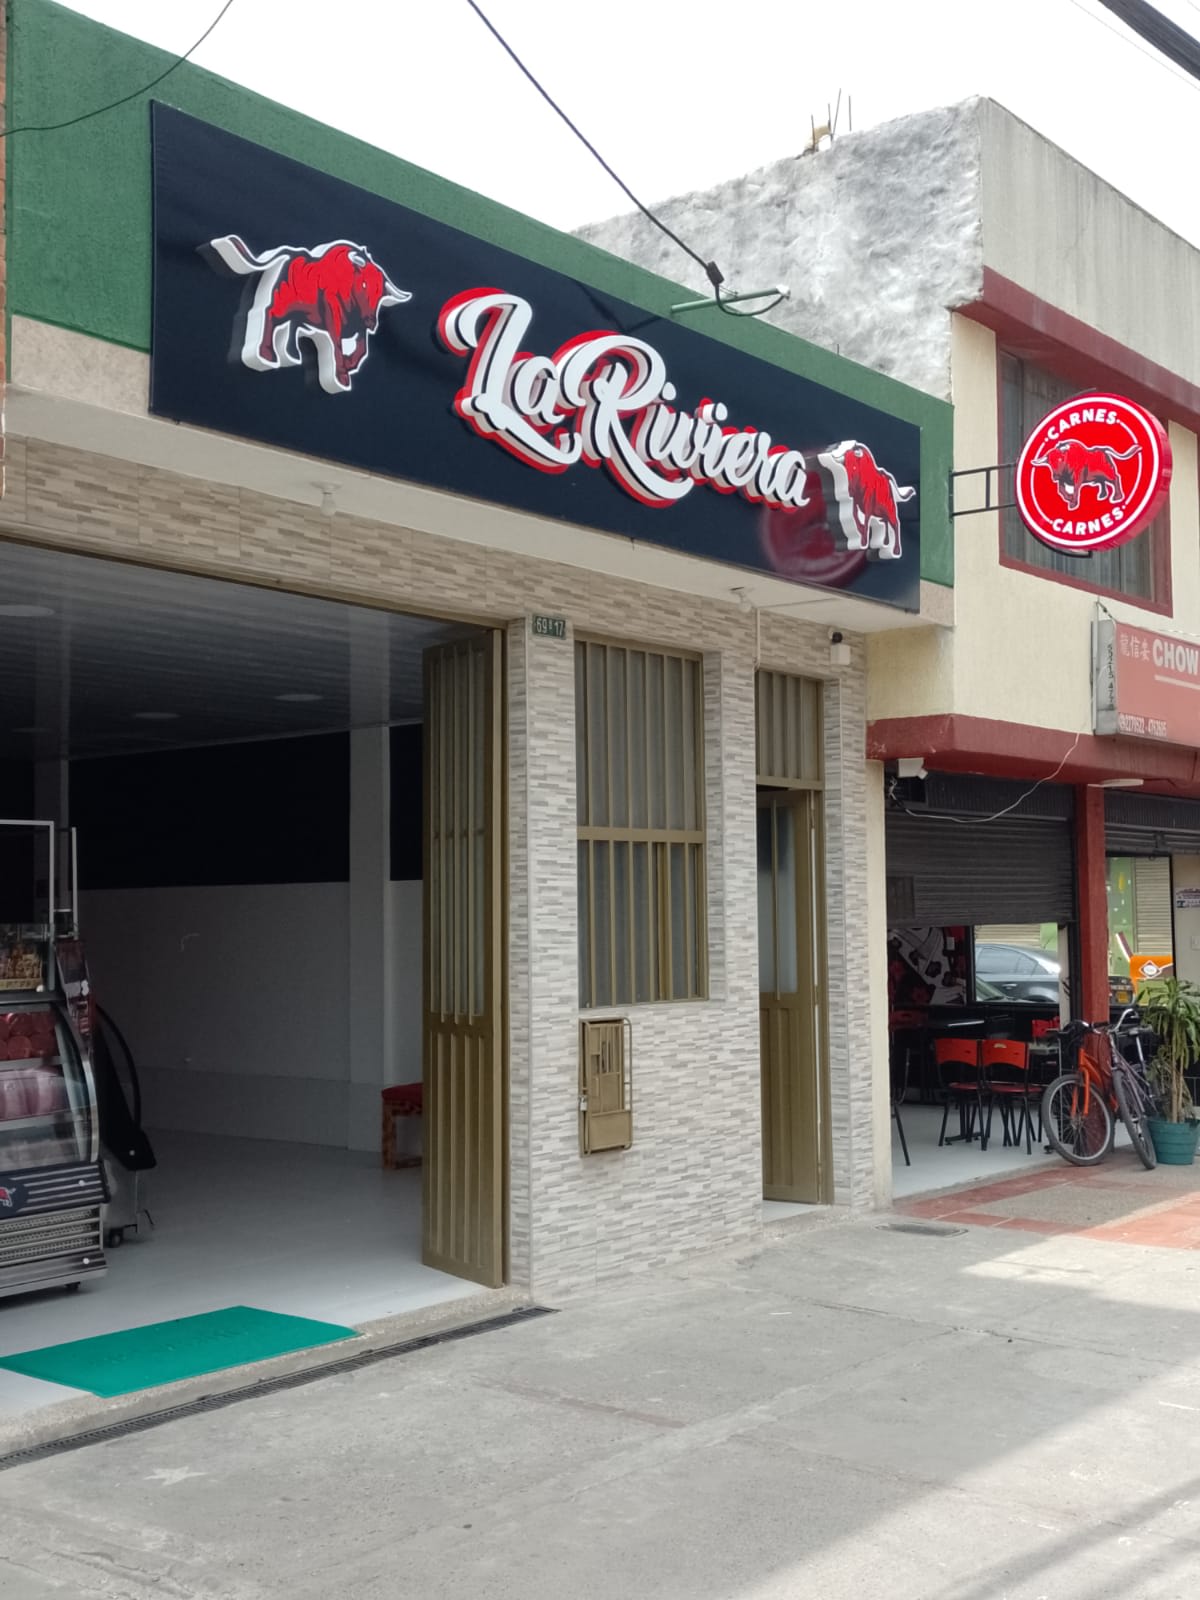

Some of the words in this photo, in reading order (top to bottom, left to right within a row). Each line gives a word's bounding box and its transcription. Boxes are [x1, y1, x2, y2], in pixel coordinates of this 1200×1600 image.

[439, 287, 584, 474] La
[553, 330, 811, 511] Riviera
[1047, 408, 1117, 440] CARNES
[1052, 506, 1123, 535] CARNES
[1152, 638, 1200, 676] CHOW
